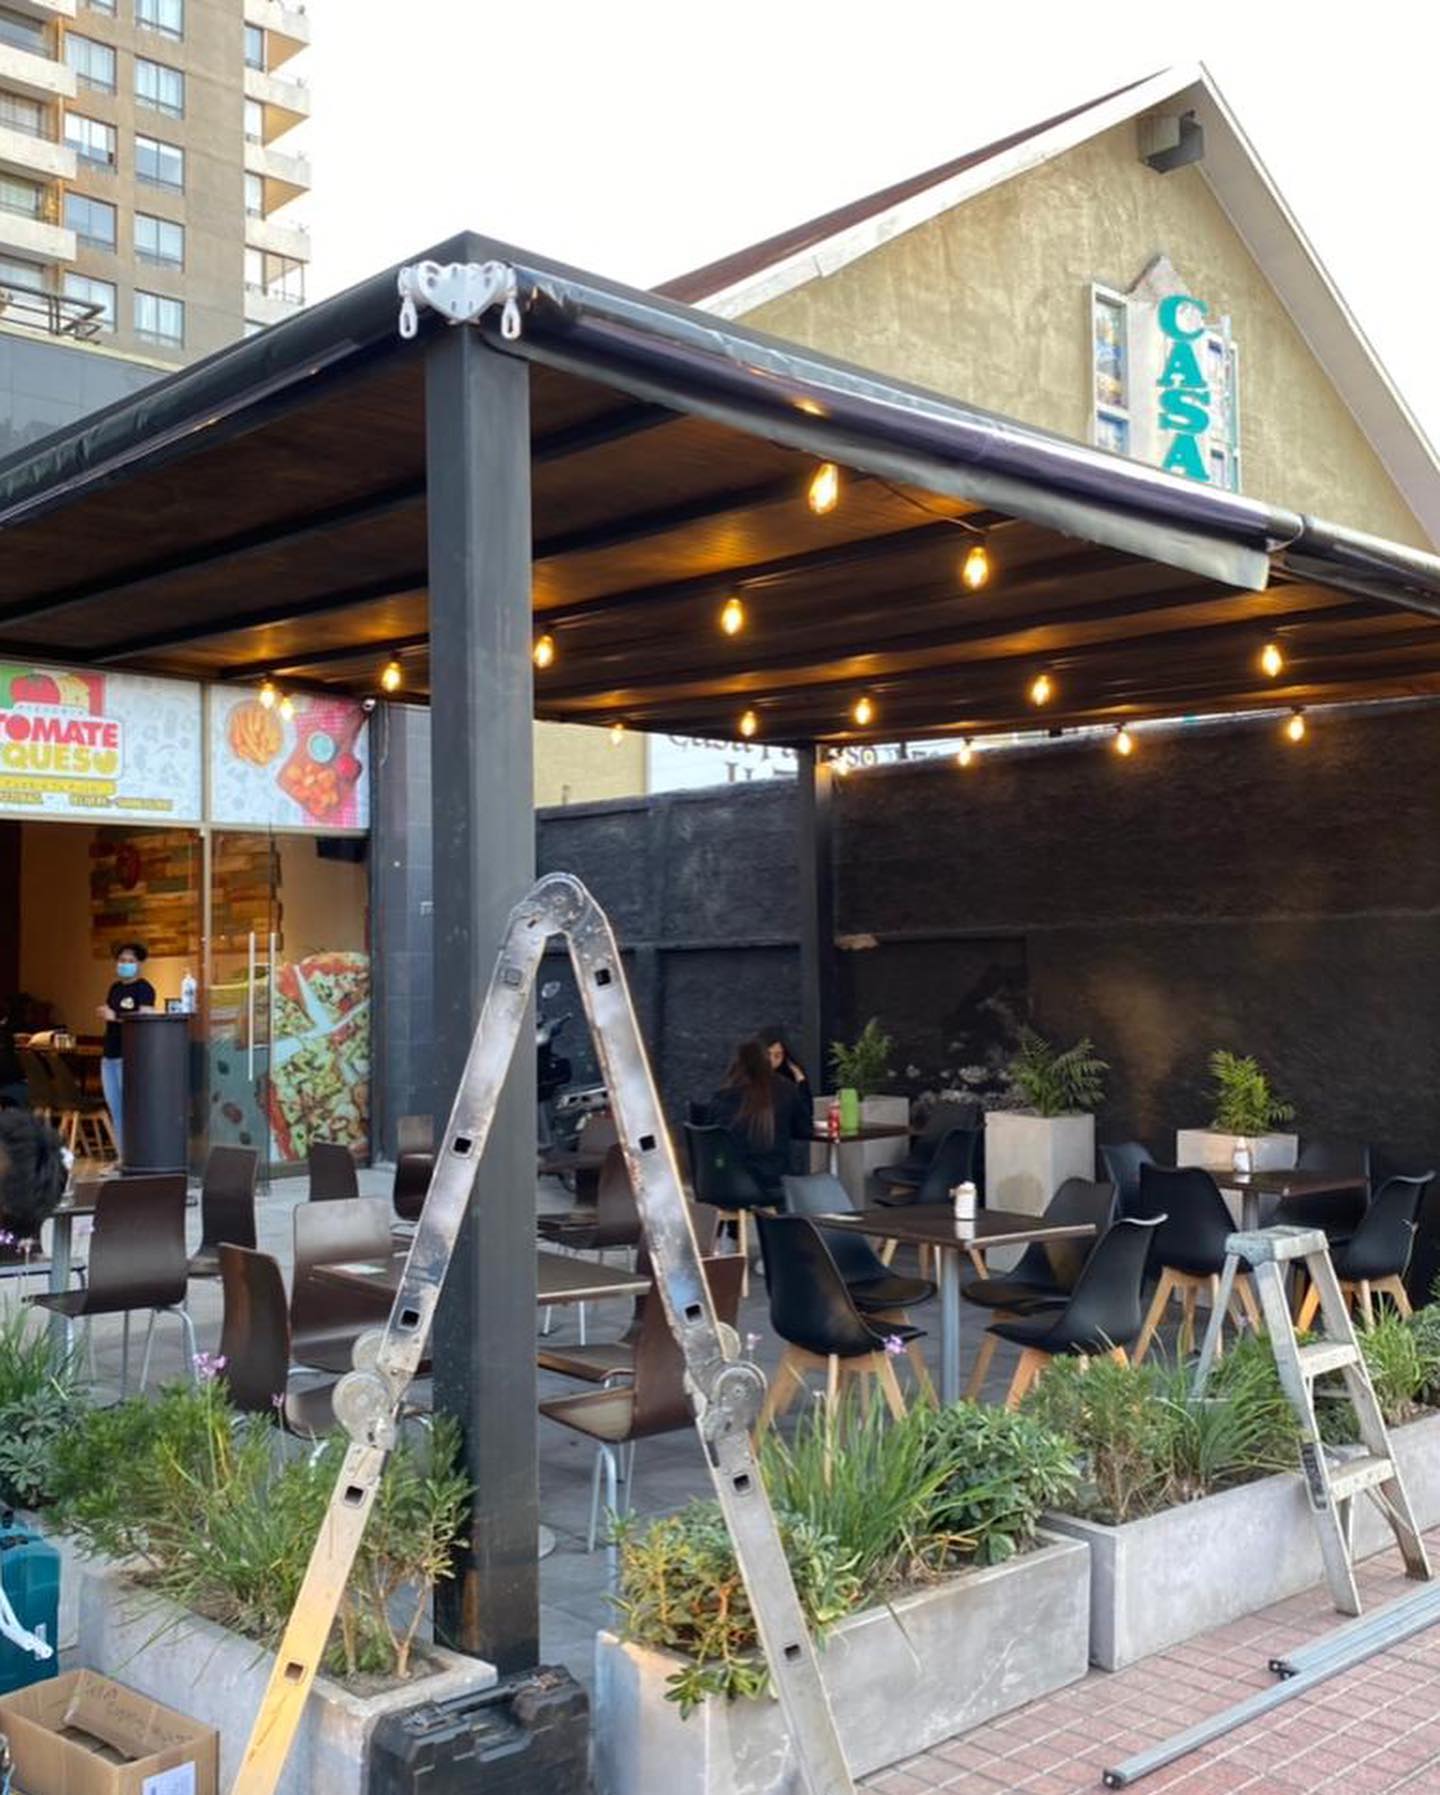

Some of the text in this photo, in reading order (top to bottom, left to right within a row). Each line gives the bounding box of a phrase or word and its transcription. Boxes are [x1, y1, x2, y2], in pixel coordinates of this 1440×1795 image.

[1157, 294, 1211, 482] CASA
[0, 712, 119, 749] OMATE
[2, 741, 119, 775] QUESO
